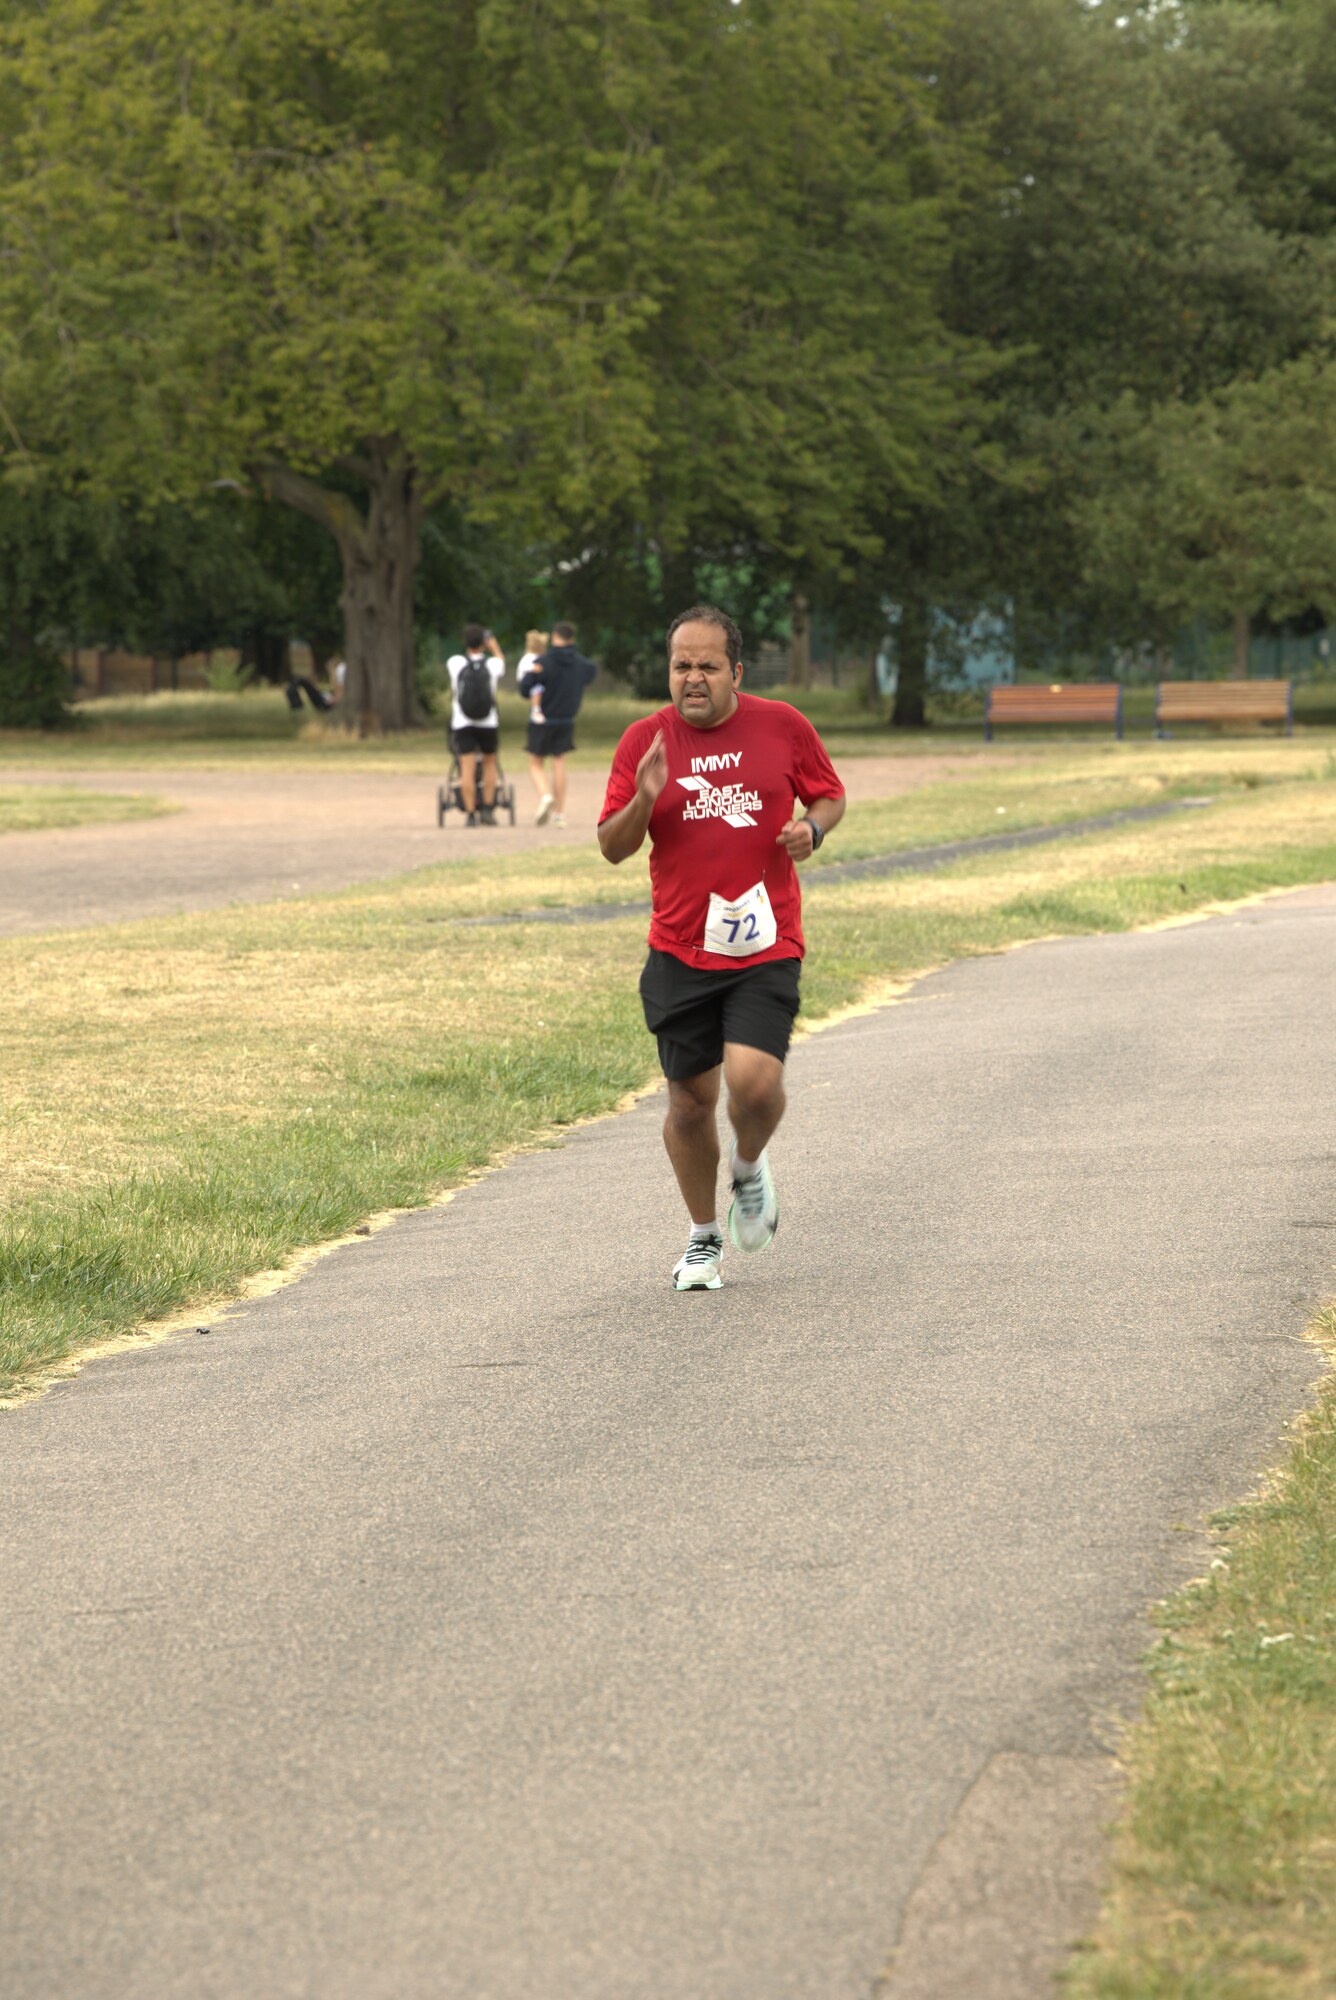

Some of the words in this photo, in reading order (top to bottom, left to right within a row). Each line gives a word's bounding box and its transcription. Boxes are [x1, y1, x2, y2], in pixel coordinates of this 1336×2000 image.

[691, 751, 743, 774] IMMY
[686, 790, 758, 810] LONDON
[699, 783, 744, 800] EAST
[682, 800, 763, 821] RUNNERS
[722, 913, 760, 943] 72
